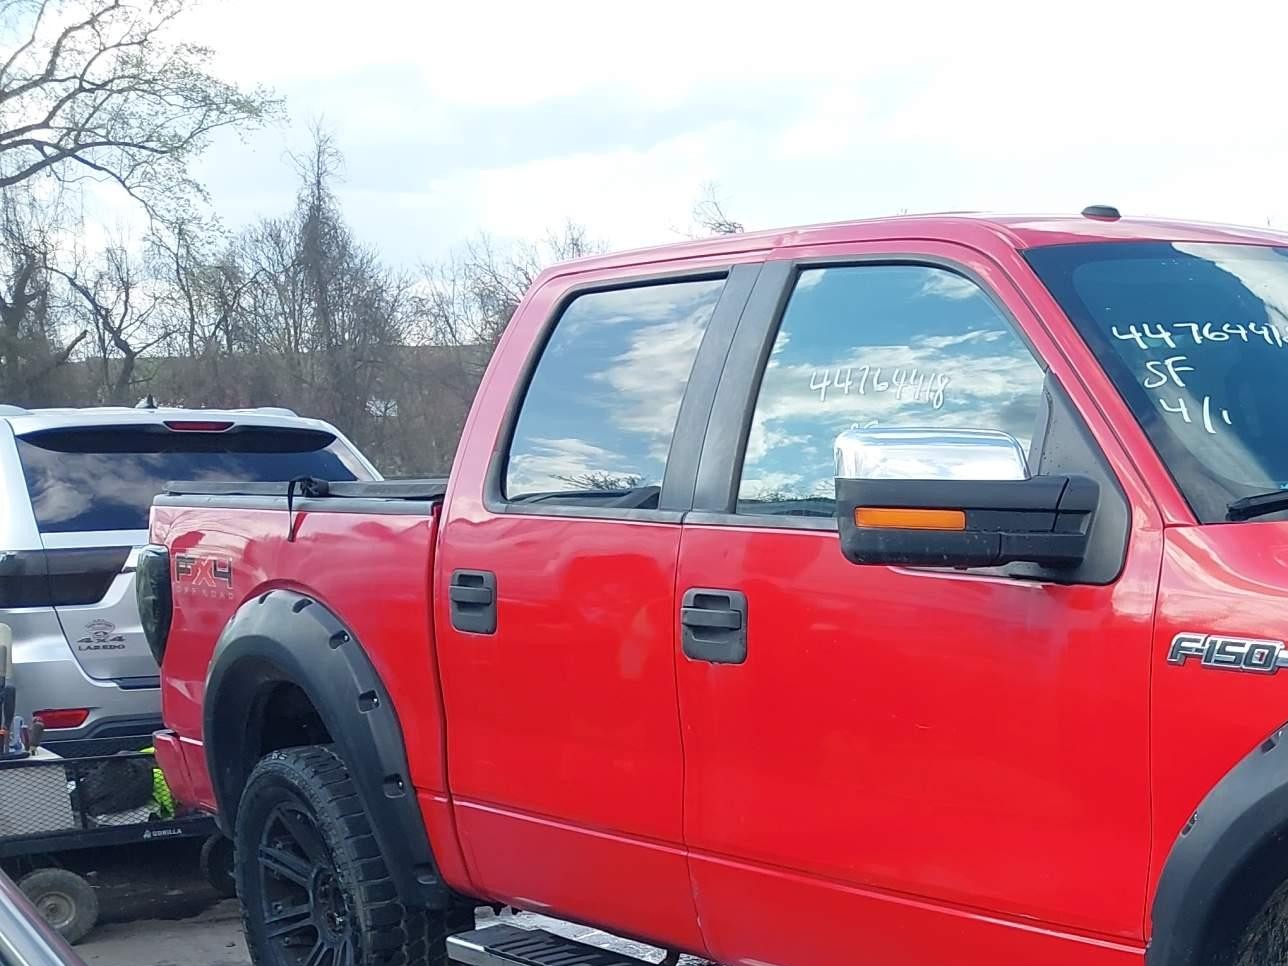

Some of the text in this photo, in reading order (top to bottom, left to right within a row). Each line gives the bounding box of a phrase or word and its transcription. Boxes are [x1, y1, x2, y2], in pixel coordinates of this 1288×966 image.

[809, 365, 949, 409] 44764418
[1143, 356, 1194, 388] SF
[175, 553, 234, 590] FX4
[1167, 632, 1286, 674] F-150
